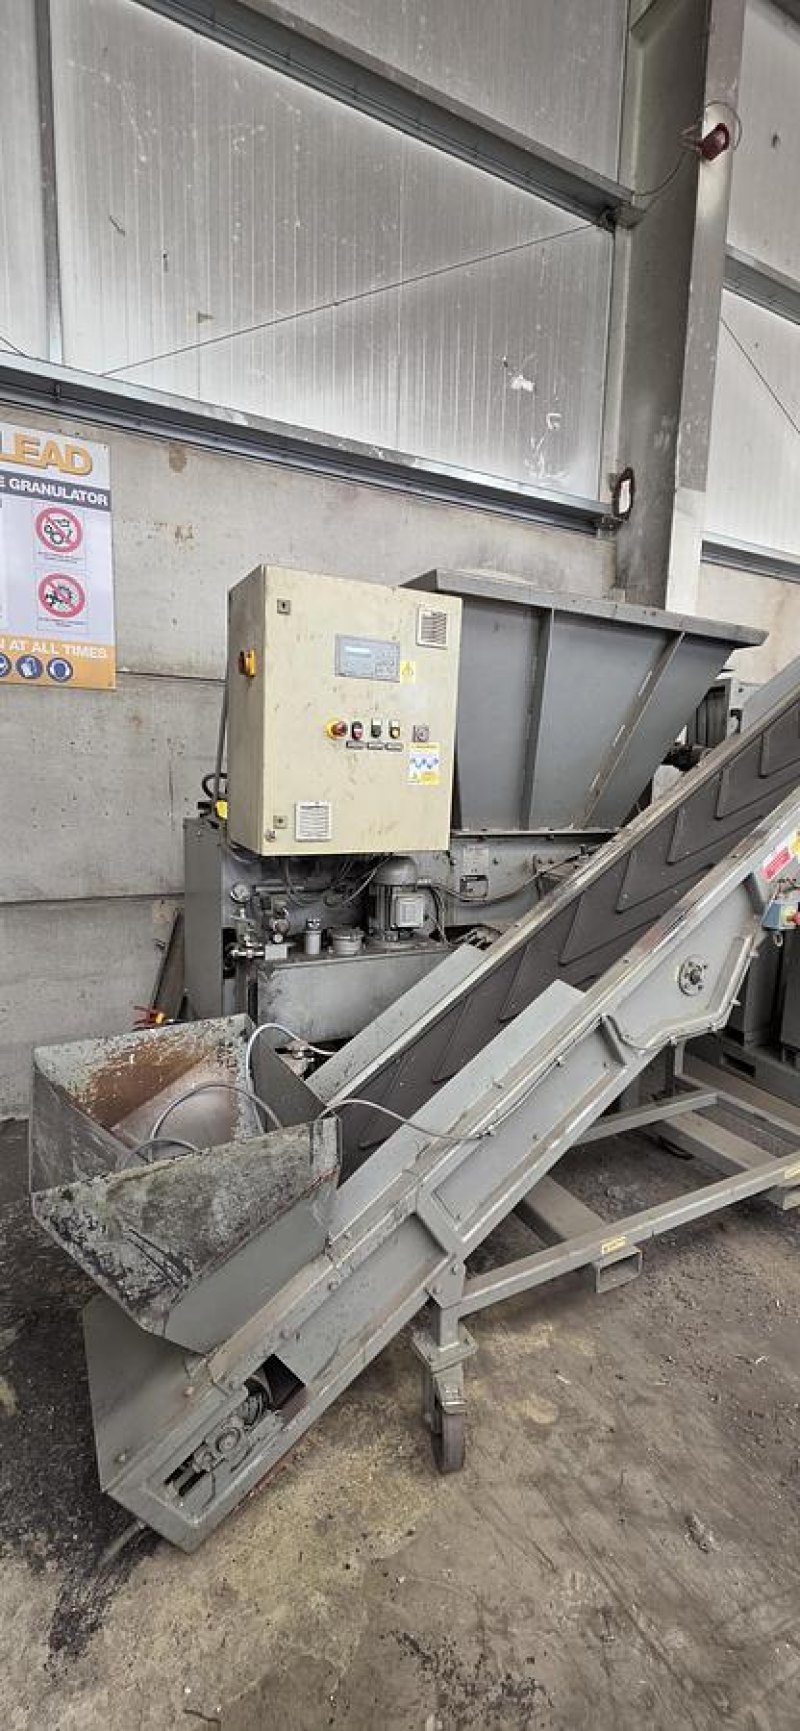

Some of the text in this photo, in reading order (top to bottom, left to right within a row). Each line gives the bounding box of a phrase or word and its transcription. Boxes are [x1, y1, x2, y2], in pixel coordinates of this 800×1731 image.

[9, 478, 109, 507] GRANULATOR
[9, 639, 26, 651] AT
[31, 641, 59, 655] ALL
[64, 643, 107, 659] TIMES
